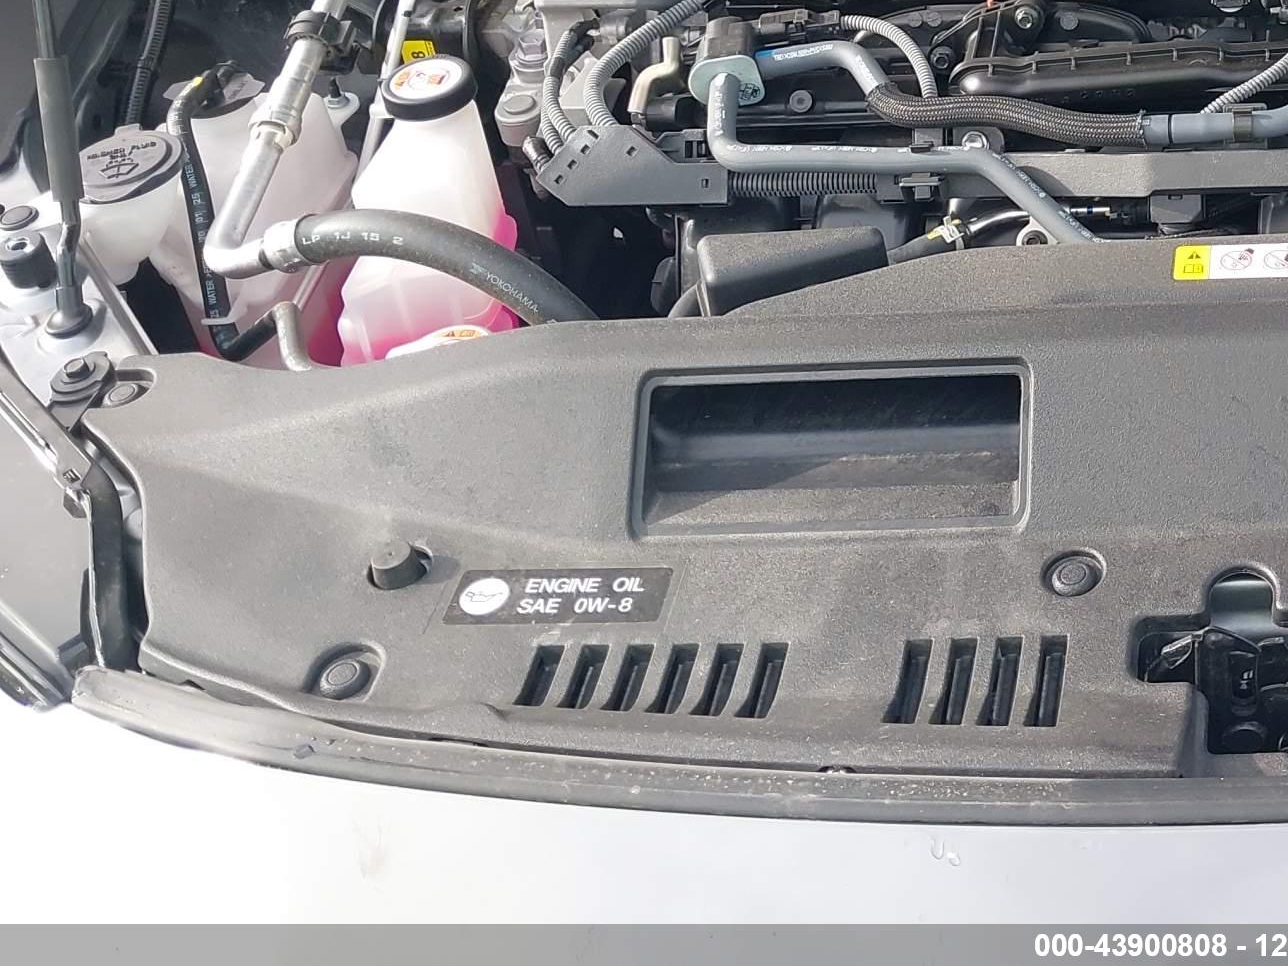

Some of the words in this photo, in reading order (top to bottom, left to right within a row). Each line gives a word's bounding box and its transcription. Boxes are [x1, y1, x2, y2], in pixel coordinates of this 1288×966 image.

[205, 280, 217, 305] WATER
[485, 272, 539, 314] YOKOHAMA
[524, 577, 602, 594] ENGINE
[612, 577, 645, 593] OIL
[516, 598, 562, 614] SAE
[573, 597, 633, 613] 0W-8
